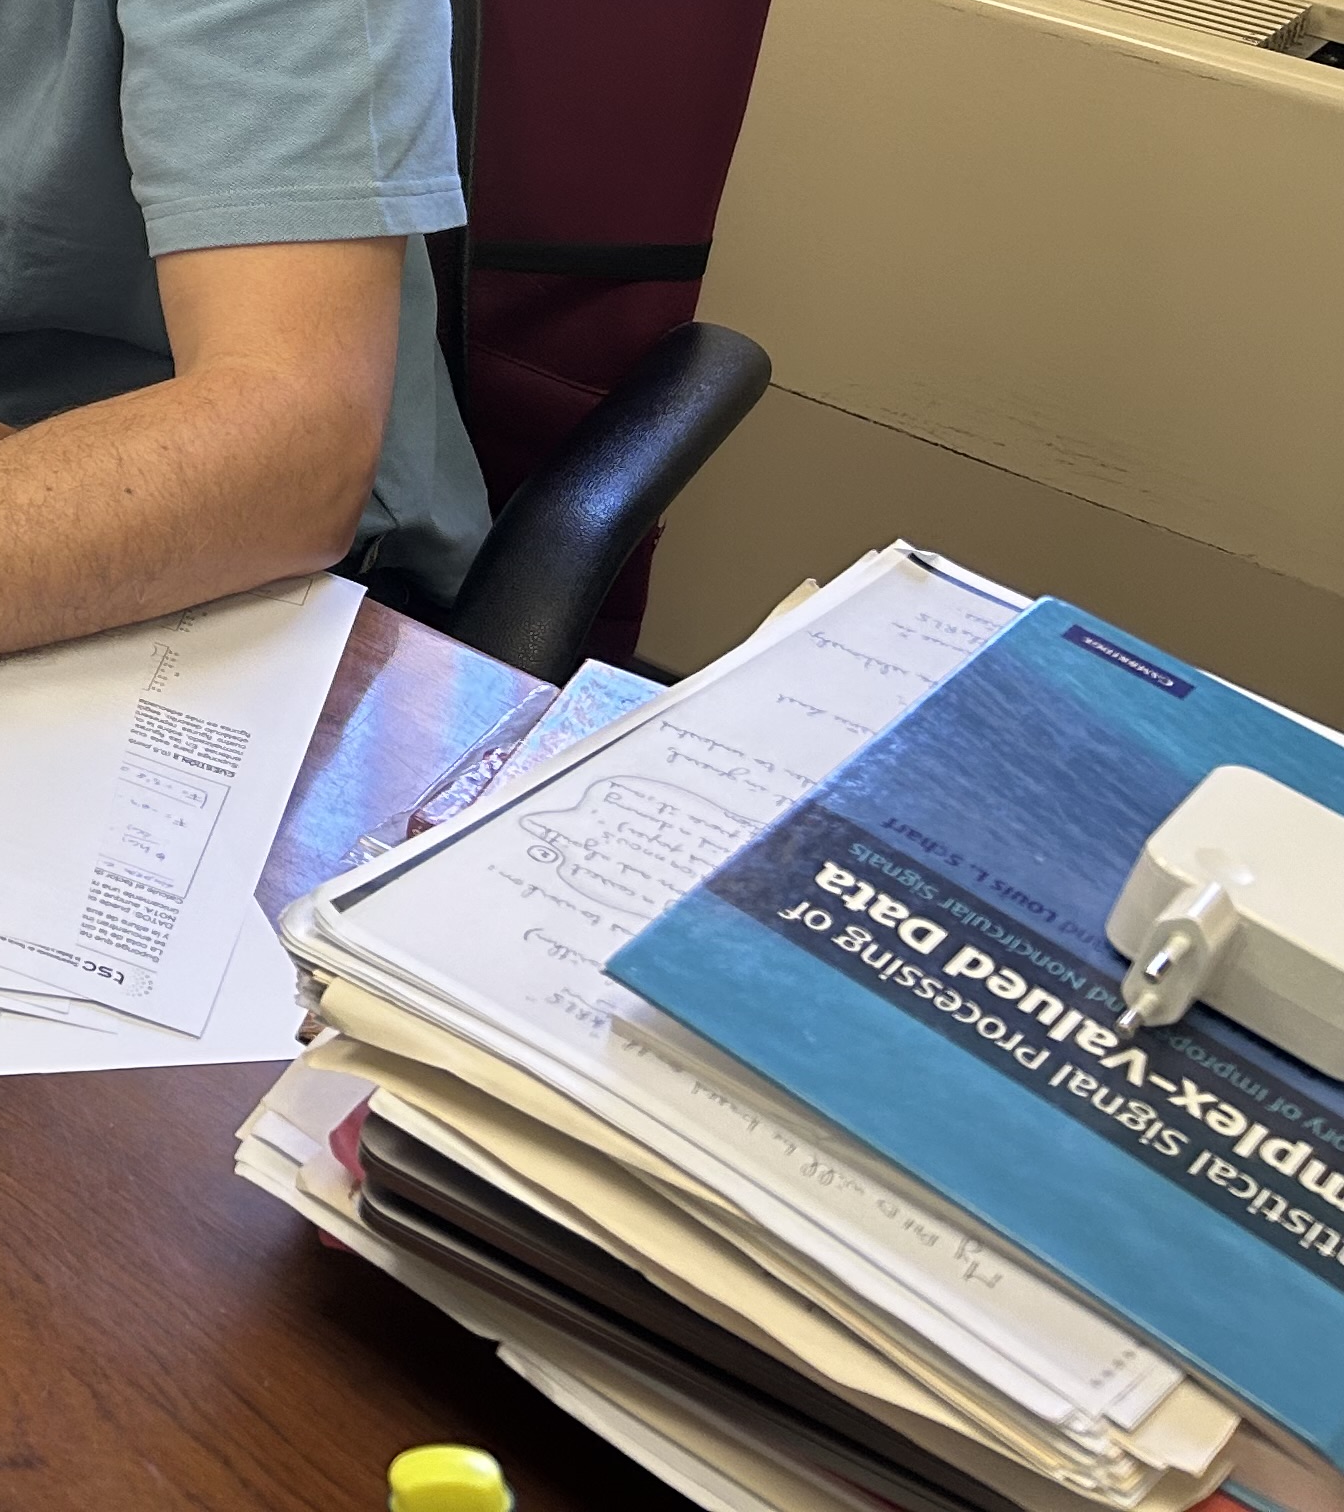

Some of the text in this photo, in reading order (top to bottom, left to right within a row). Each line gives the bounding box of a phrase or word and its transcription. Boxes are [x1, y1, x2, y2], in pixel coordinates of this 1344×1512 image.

[878, 810, 965, 871] Scharf
[848, 842, 939, 901] Signals
[962, 860, 992, 886] L.
[987, 874, 1060, 926] Louis
[776, 901, 833, 931] of
[814, 861, 948, 955] Data
[82, 960, 125, 986] tsc
[936, 898, 1088, 991] Noncircular
[830, 925, 1061, 1070] Processing
[1085, 986, 1129, 1012] nd
[1173, 1039, 1269, 1102] Improp
[1048, 1064, 1189, 1156] Signal
[1264, 1097, 1303, 1121] of
